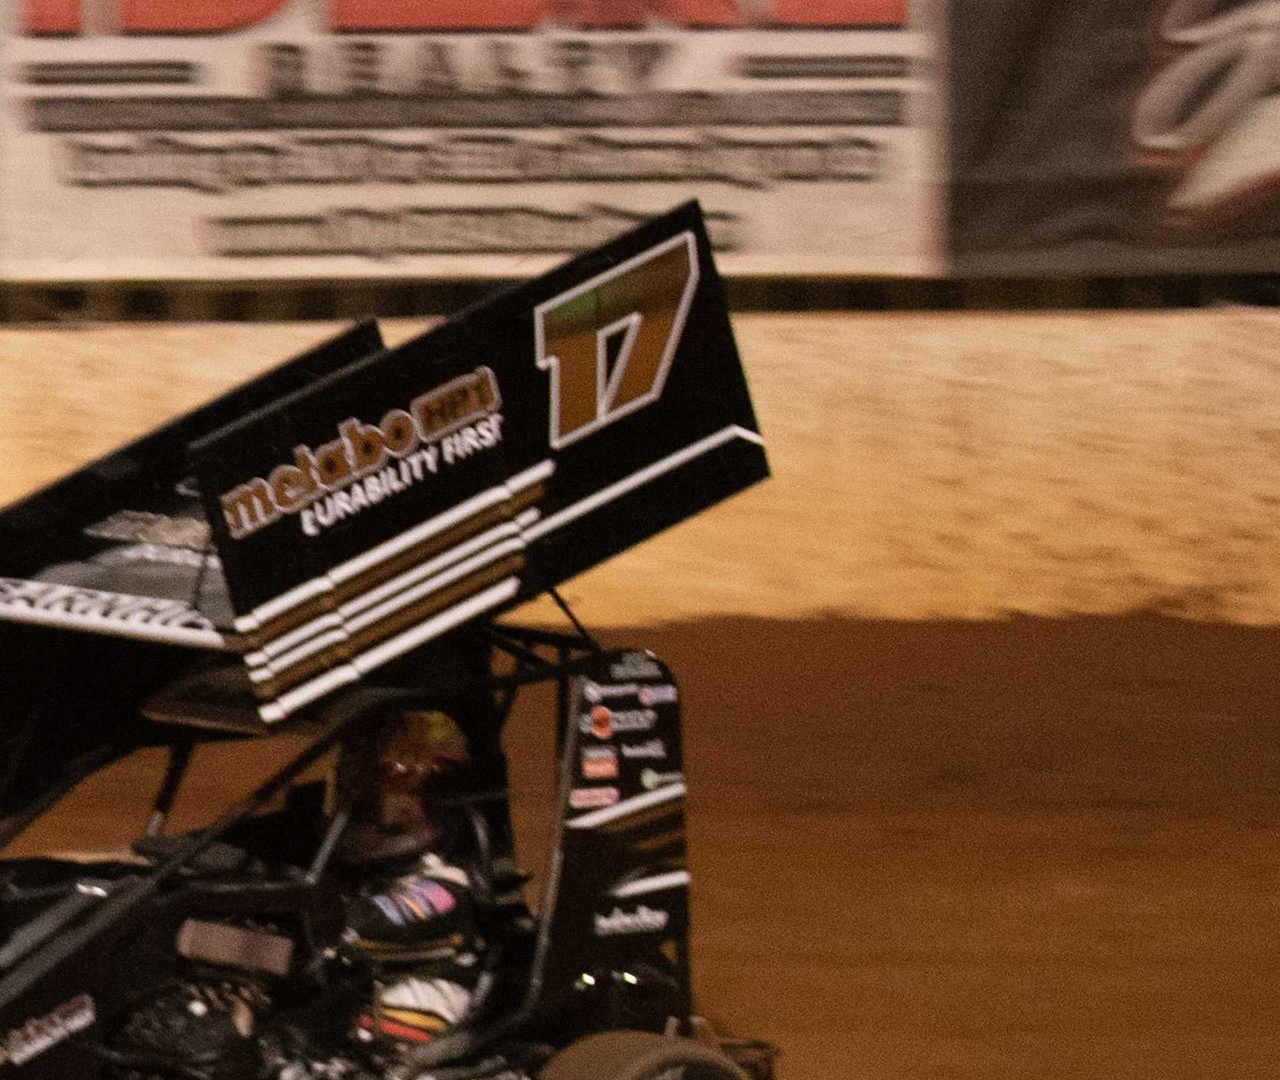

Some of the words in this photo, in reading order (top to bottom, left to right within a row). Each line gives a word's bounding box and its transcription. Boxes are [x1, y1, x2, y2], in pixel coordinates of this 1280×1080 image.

[535, 231, 700, 450] 17
[220, 409, 419, 540] metabo
[442, 412, 503, 464] FIRST
